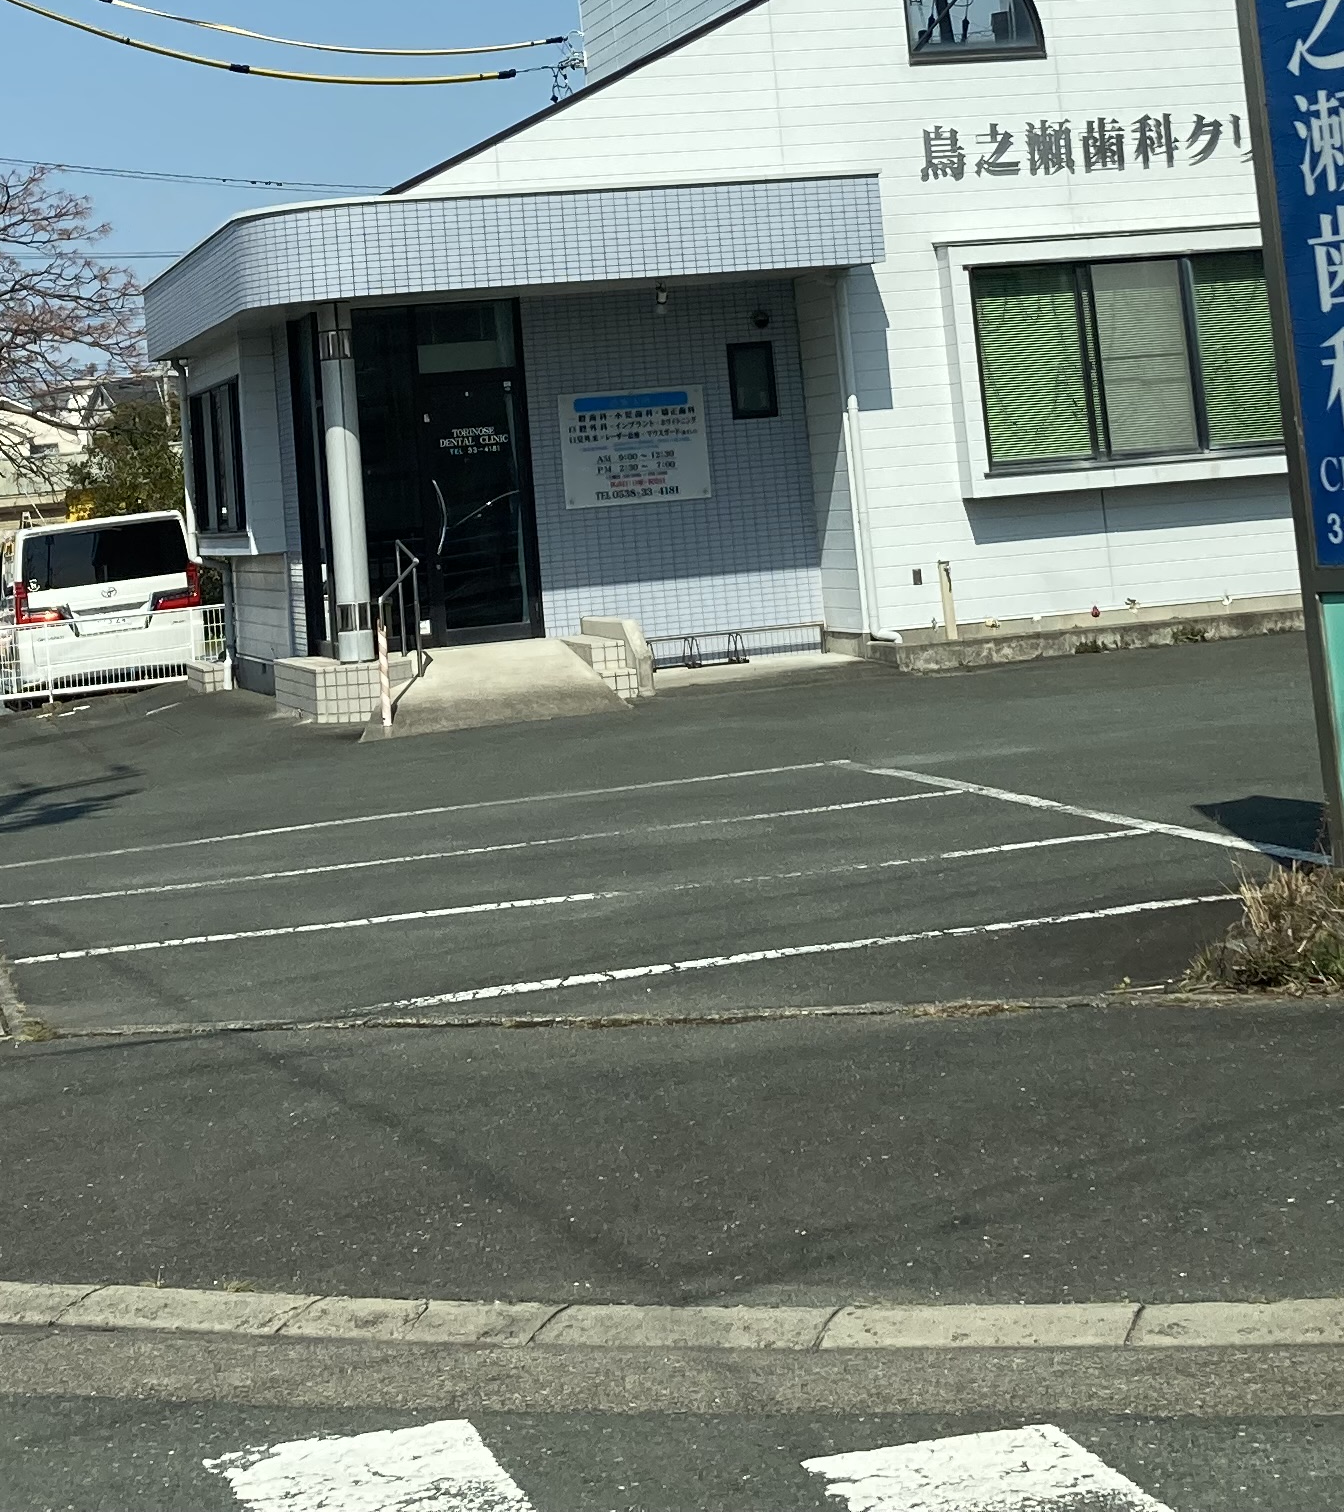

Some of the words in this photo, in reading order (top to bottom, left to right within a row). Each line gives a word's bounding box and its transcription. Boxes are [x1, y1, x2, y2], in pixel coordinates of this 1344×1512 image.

[452, 427, 495, 437] TORINOSE
[440, 437, 475, 447] DENTAL
[480, 434, 509, 444] CLINIC
[450, 448, 463, 456] TEL
